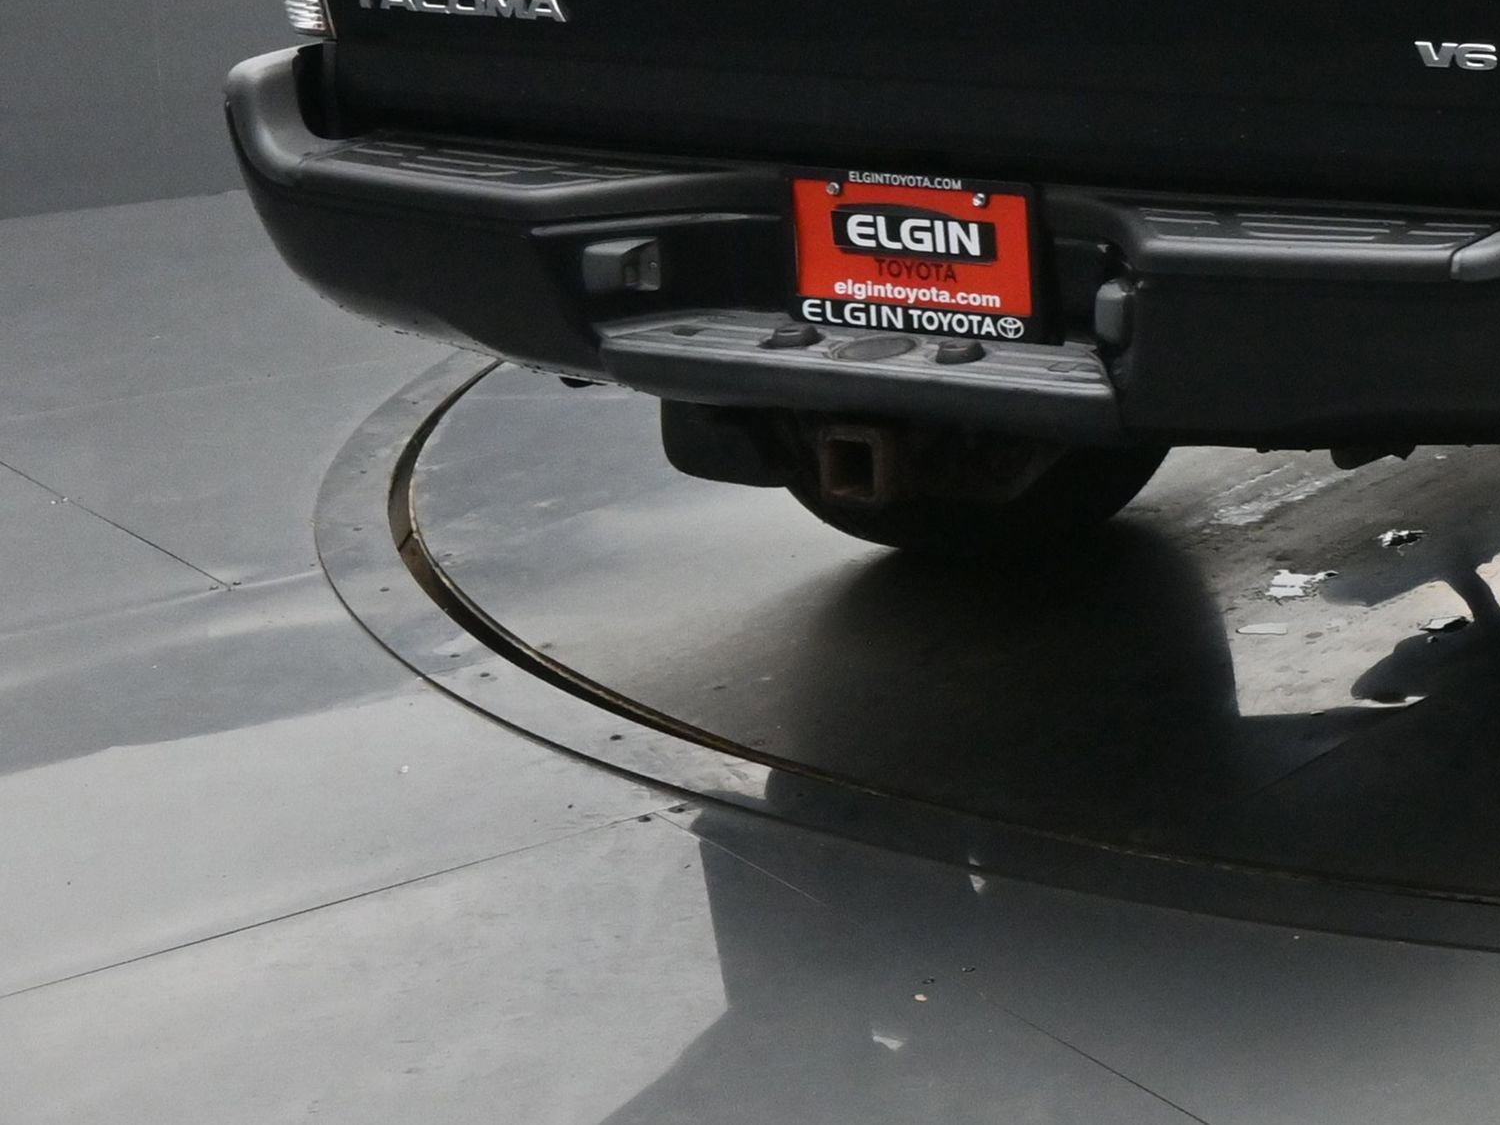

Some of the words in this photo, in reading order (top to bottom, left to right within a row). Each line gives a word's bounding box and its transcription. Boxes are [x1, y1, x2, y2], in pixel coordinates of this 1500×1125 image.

[1414, 41, 1498, 70] V6
[848, 171, 962, 190] ELGINTOYOTA.COM
[847, 214, 981, 256] ELGIN
[876, 259, 958, 283] TOYOTA
[834, 279, 1001, 308] elgintoyota.com
[802, 299, 904, 329] ELGIN
[909, 309, 998, 337] TOYOTA
